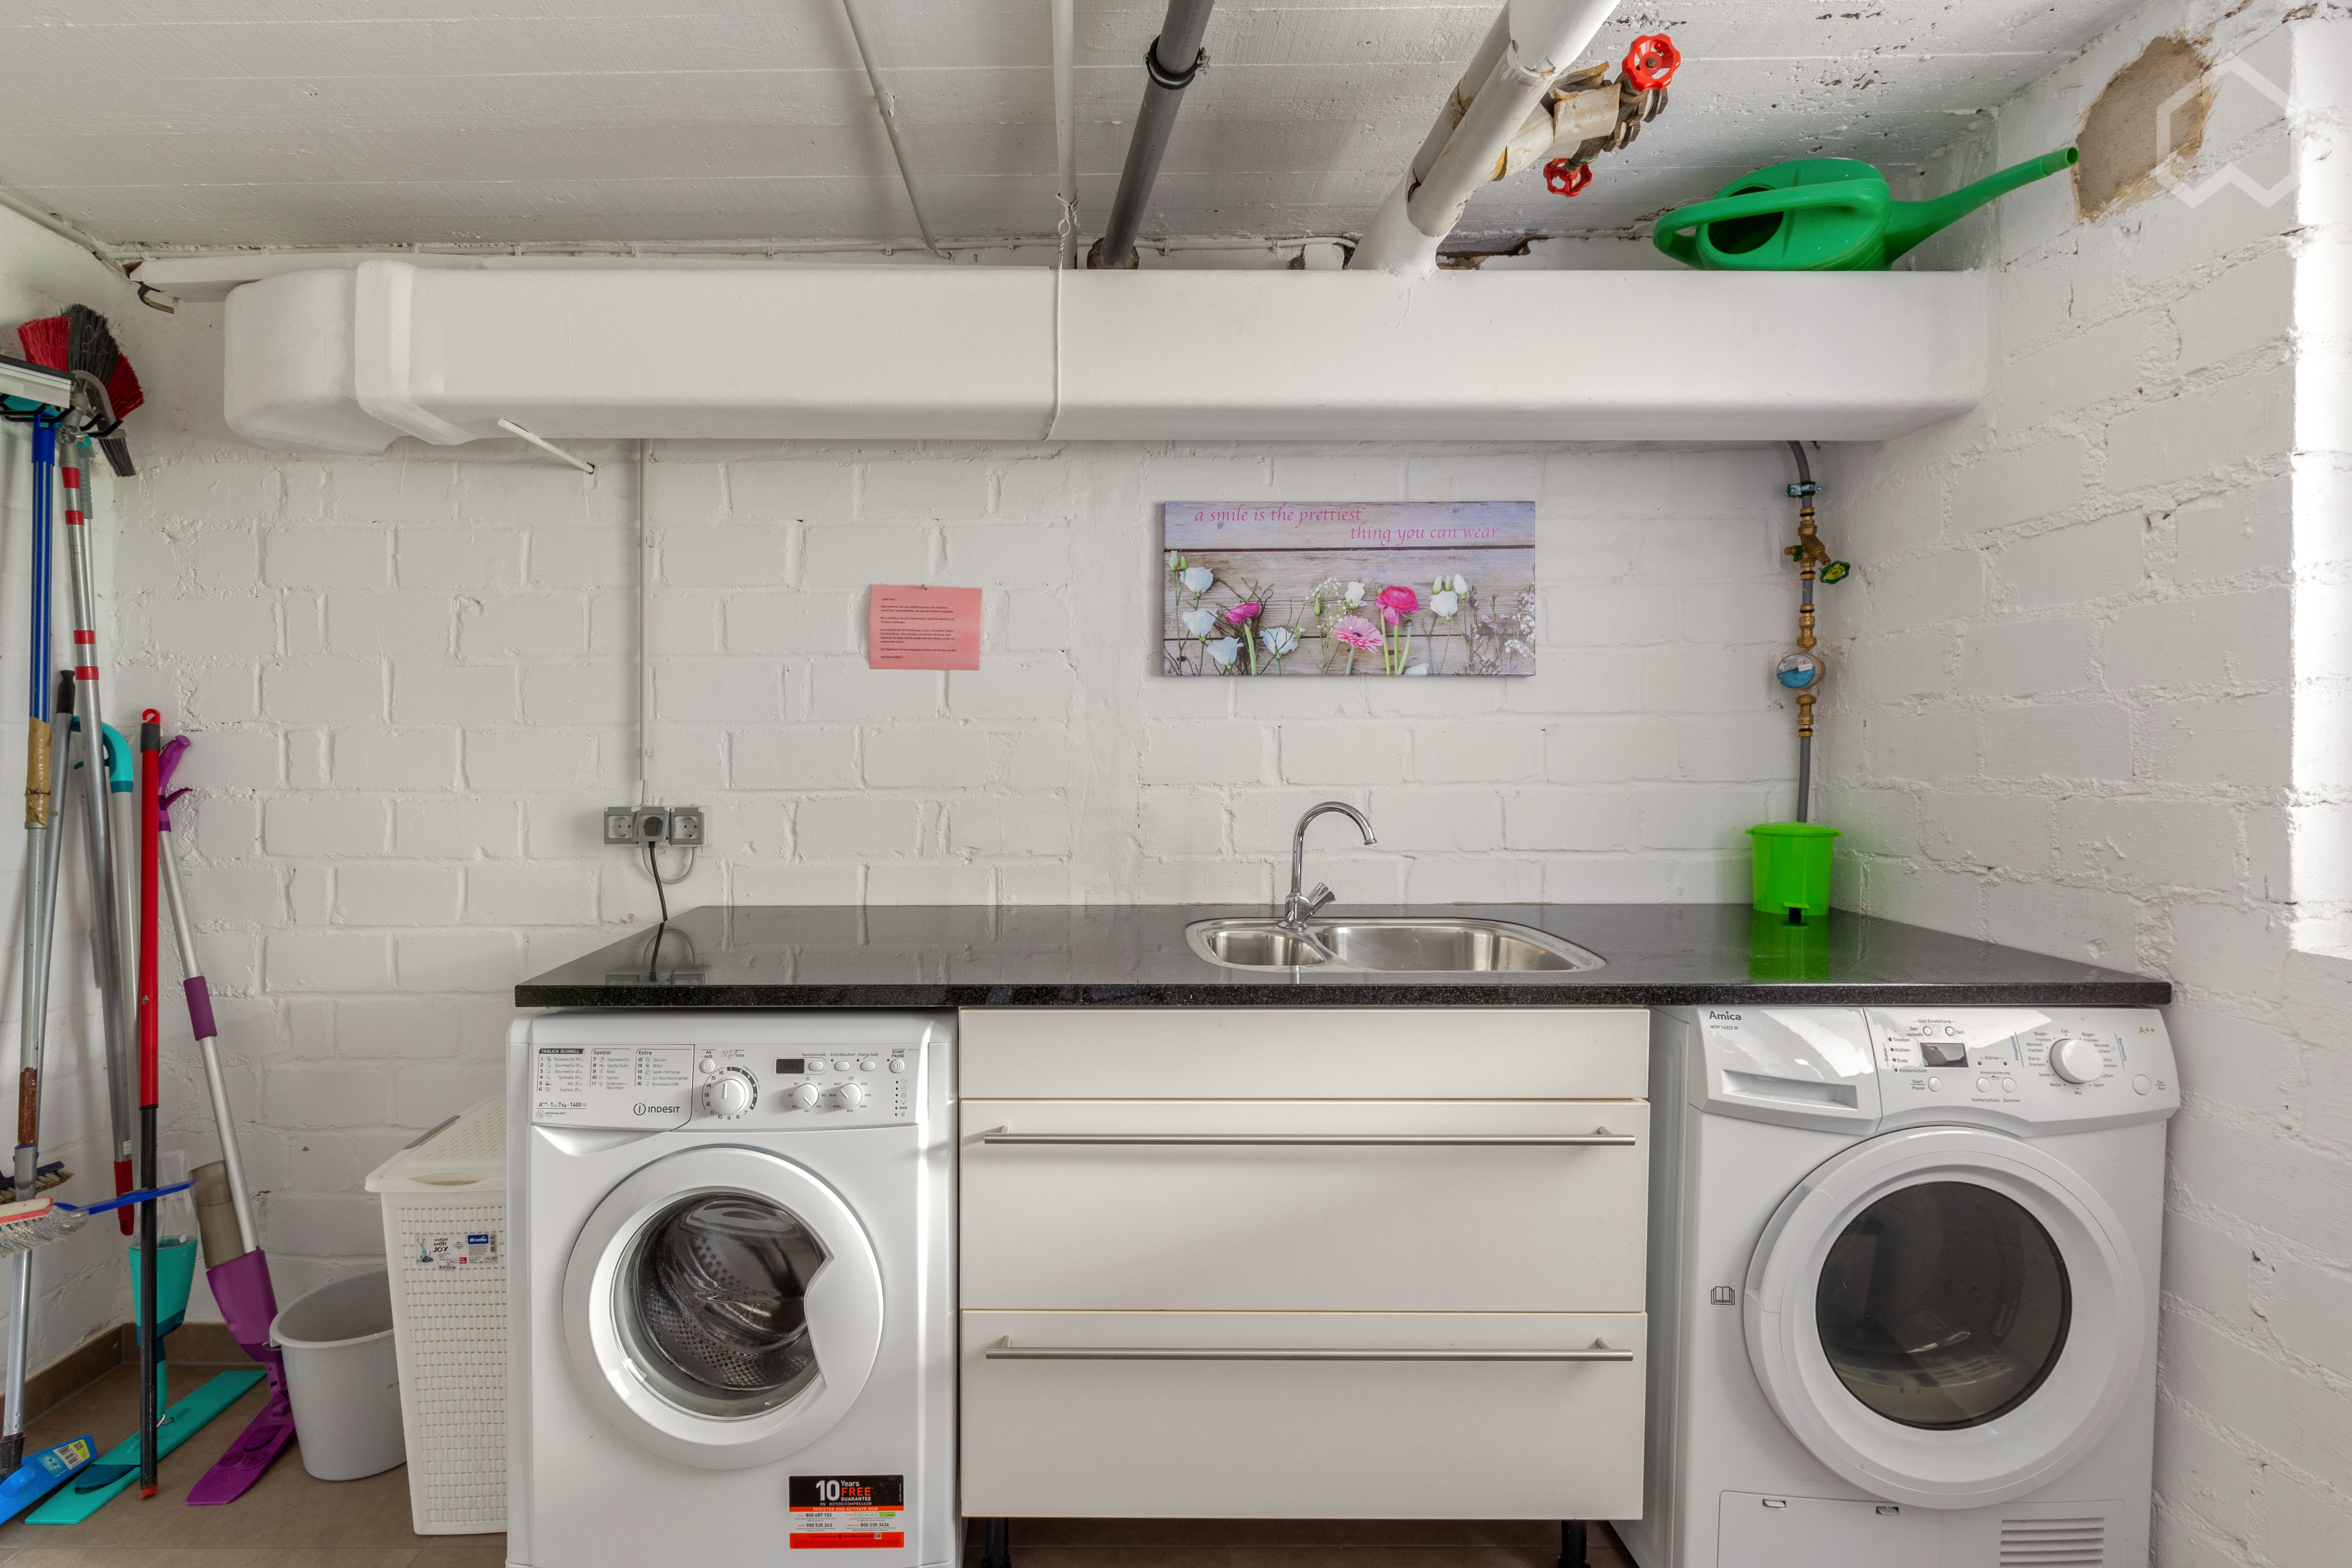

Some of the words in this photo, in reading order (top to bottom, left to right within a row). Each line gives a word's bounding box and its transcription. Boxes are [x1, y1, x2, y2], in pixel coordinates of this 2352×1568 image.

[1195, 510, 1203, 521] a
[1209, 505, 1248, 521] smile
[1254, 507, 1265, 521] is
[1271, 504, 1293, 521] the
[1295, 507, 1362, 528] prettiest
[1350, 522, 1391, 546] thing
[1396, 527, 1425, 546] you
[1430, 527, 1457, 538] can
[1462, 527, 1499, 538] wear
[1709, 1011, 1741, 1020] Amica
[721, 1050, 745, 1060] MyTime
[2118, 1038, 2127, 1061] Baumwolle
[816, 1480, 840, 1501] 10
[842, 1487, 871, 1496] FREE
